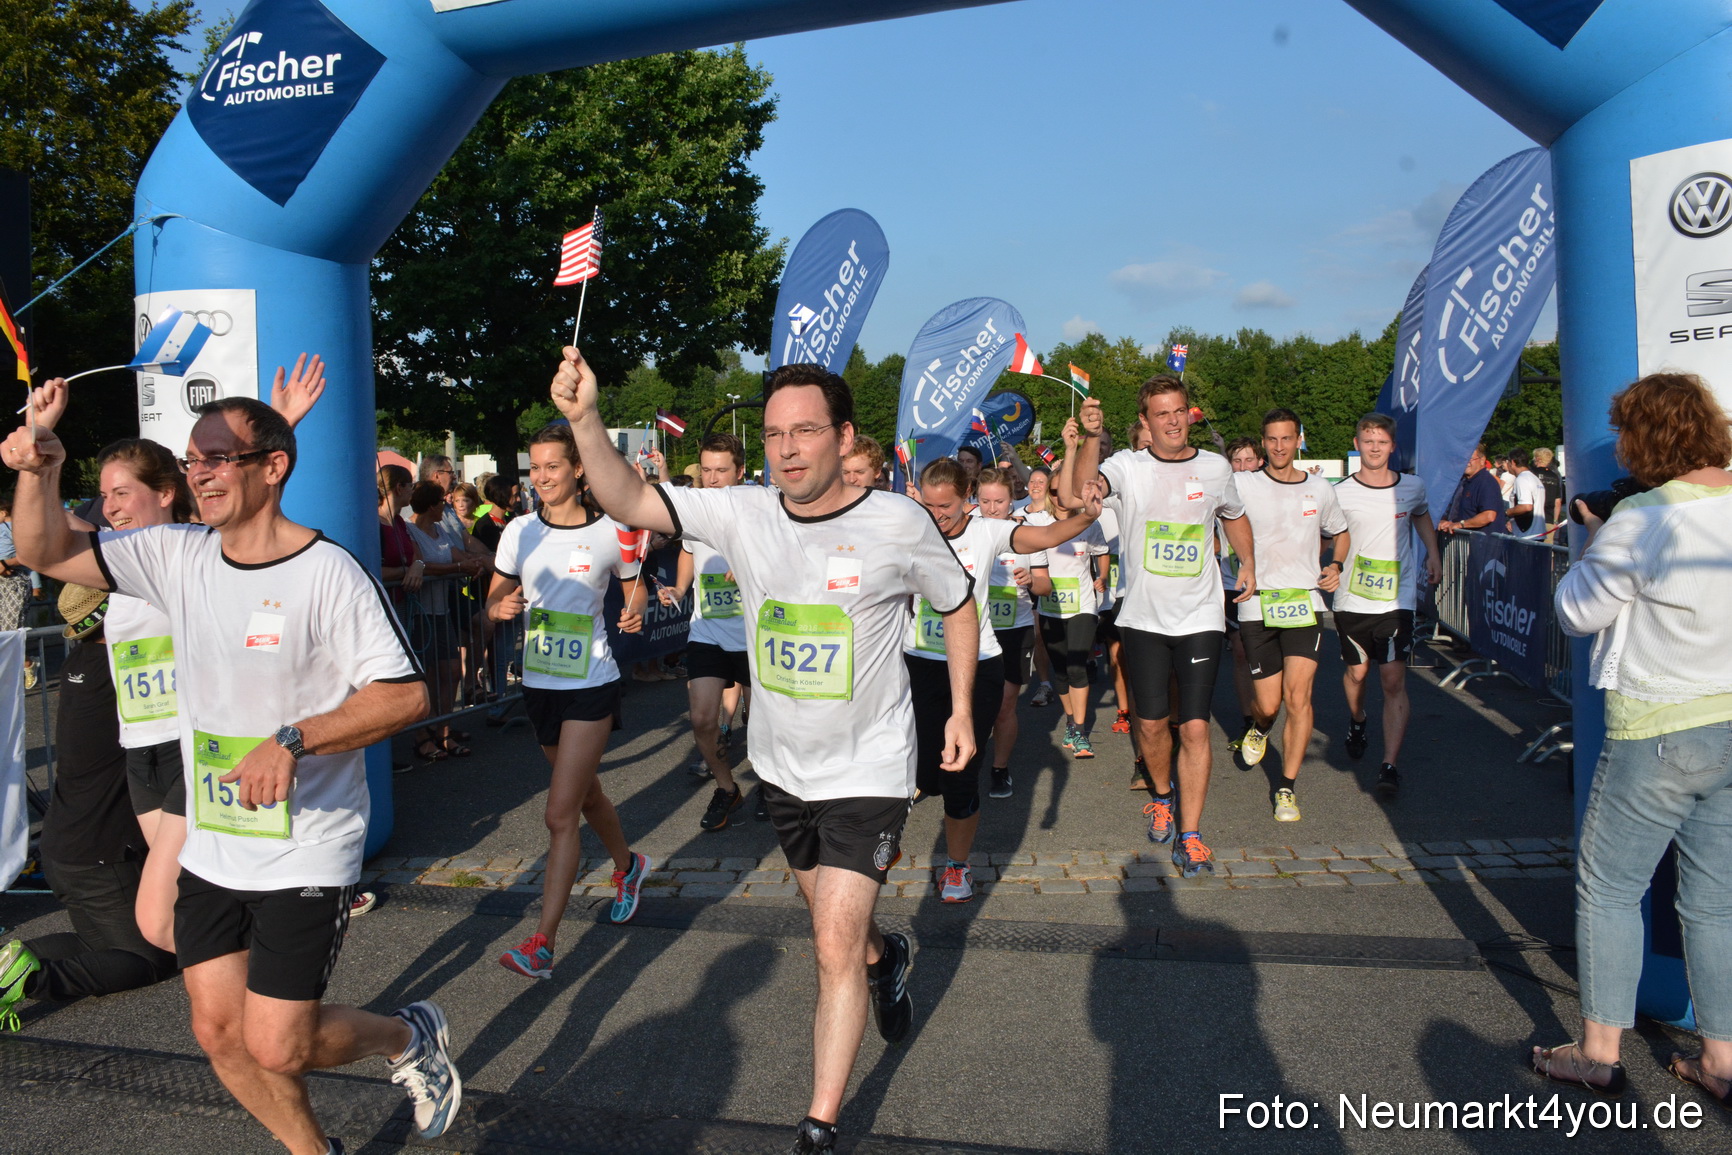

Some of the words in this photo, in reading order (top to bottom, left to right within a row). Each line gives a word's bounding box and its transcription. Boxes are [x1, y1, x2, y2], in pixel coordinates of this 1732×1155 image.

[216, 51, 341, 91] Fischer
[224, 82, 334, 106] AUTOMOBILE
[1459, 183, 1549, 355] Fischer
[821, 265, 868, 368] UTOMOBILE
[1669, 325, 1732, 344] SEA
[929, 317, 997, 413] Fischer
[953, 334, 1006, 411] AUTOMOBILE
[189, 386, 214, 406] FIAT
[141, 413, 162, 422] SEAT
[1152, 543, 1198, 562] 1529
[1357, 572, 1393, 590] 1541
[705, 589, 743, 606] 1533
[1046, 592, 1073, 603] 1521
[989, 602, 1012, 616] 13
[1267, 604, 1308, 619] 1528
[1485, 589, 1536, 636] Fischer
[650, 620, 690, 642] AUTOMOB
[924, 620, 944, 638] 15
[532, 634, 583, 660] 1519
[765, 637, 840, 673] 1527
[238, 815, 258, 823] Pusch
